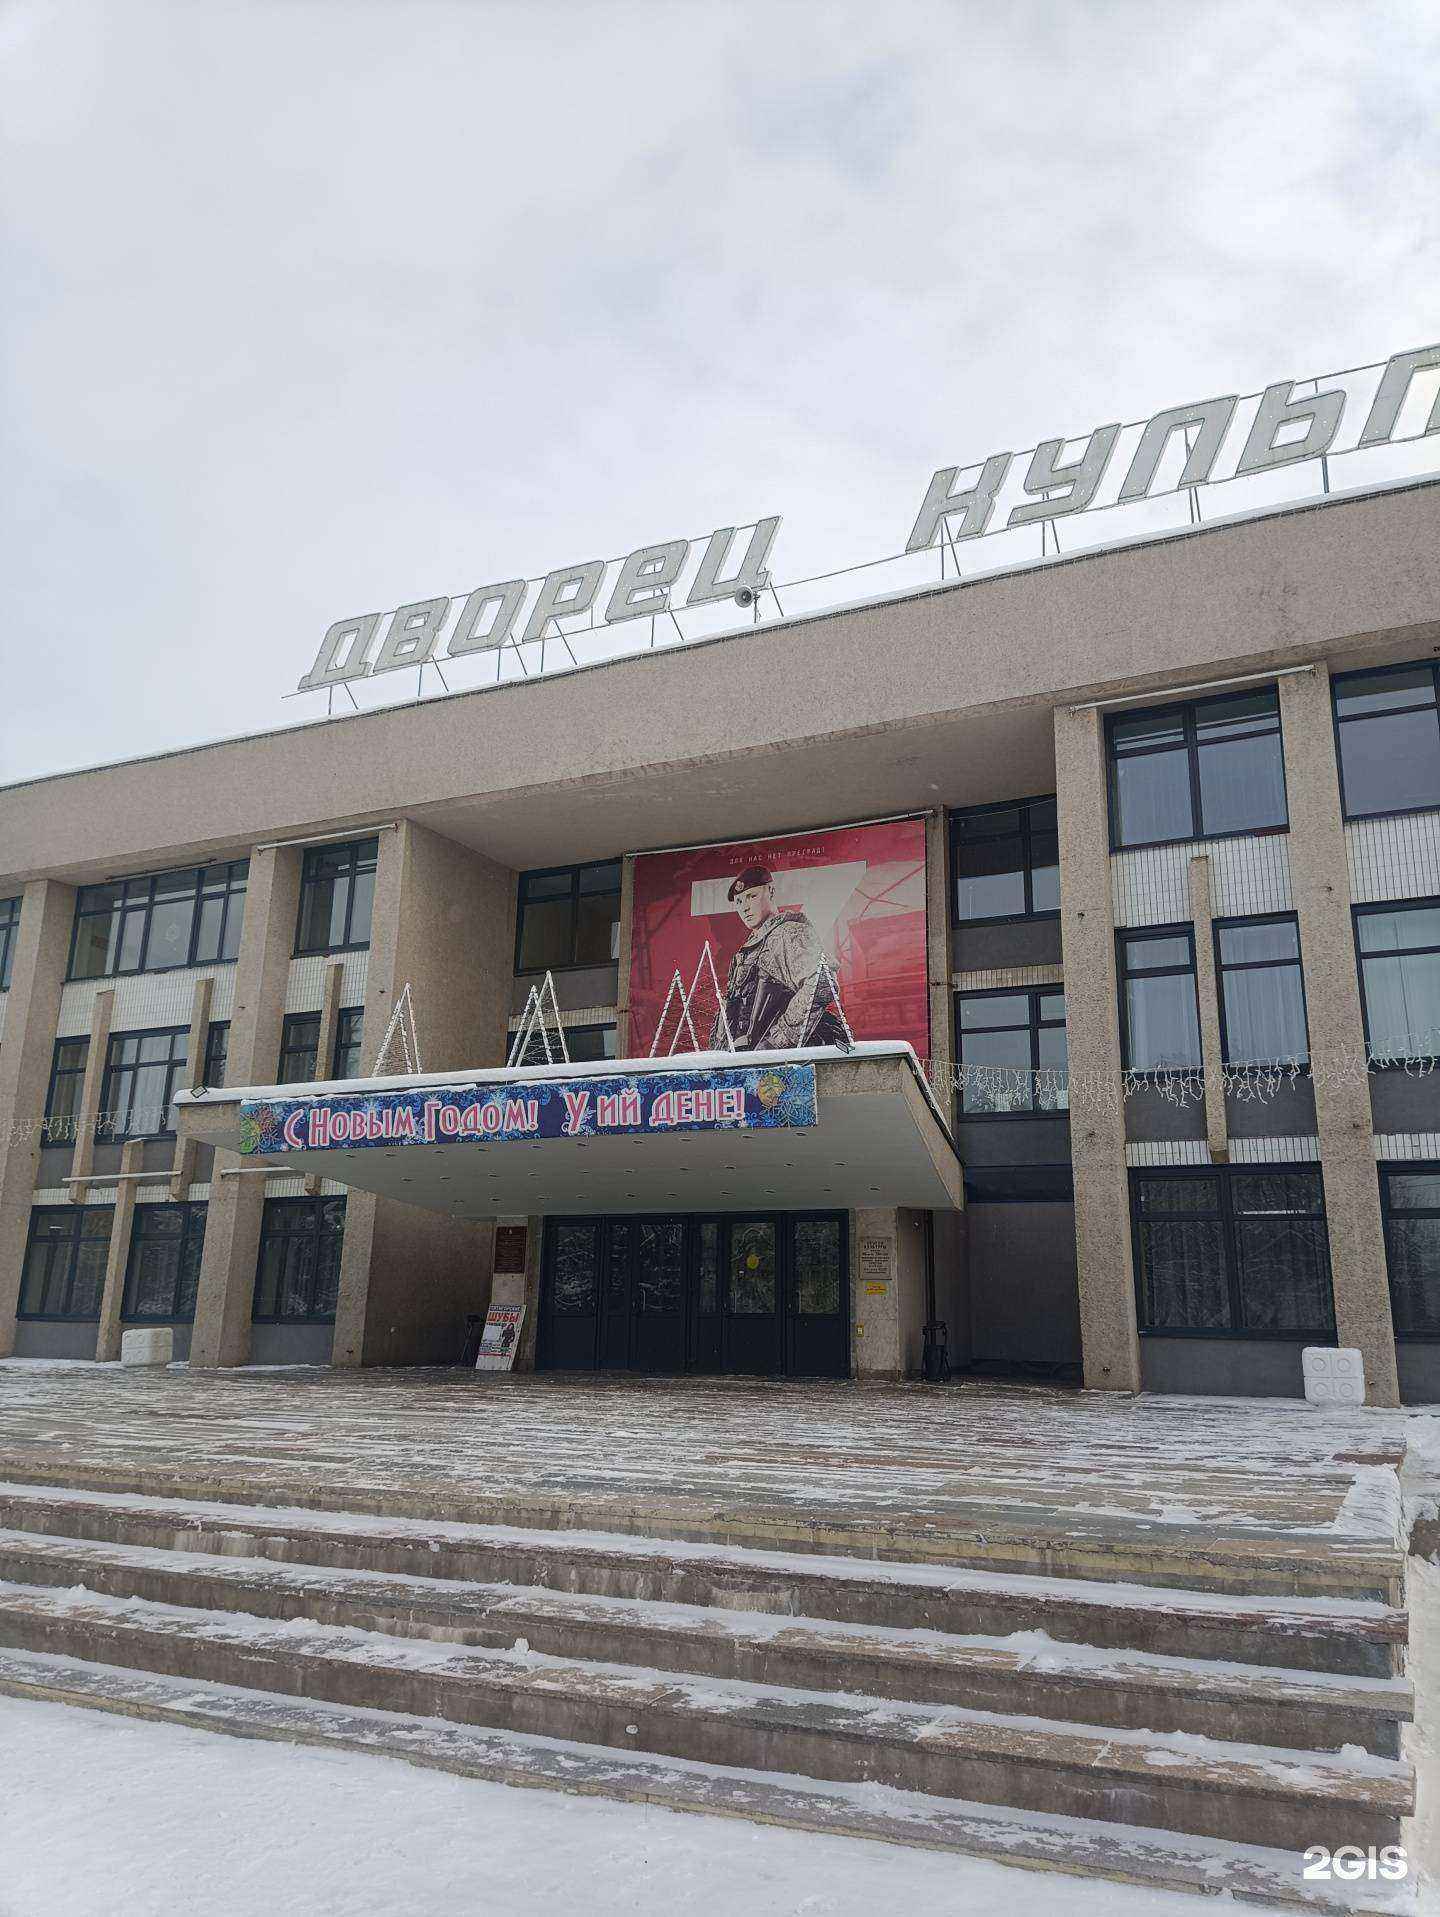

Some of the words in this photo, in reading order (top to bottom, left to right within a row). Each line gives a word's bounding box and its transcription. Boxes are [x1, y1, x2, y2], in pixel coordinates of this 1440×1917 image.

[283, 1108, 305, 1148] С
[563, 1090, 590, 1135] У
[597, 1087, 641, 1126] ИЙ
[649, 1086, 745, 1126] ДЕНЕ!
[487, 1311, 519, 1322] ШУБЫ
